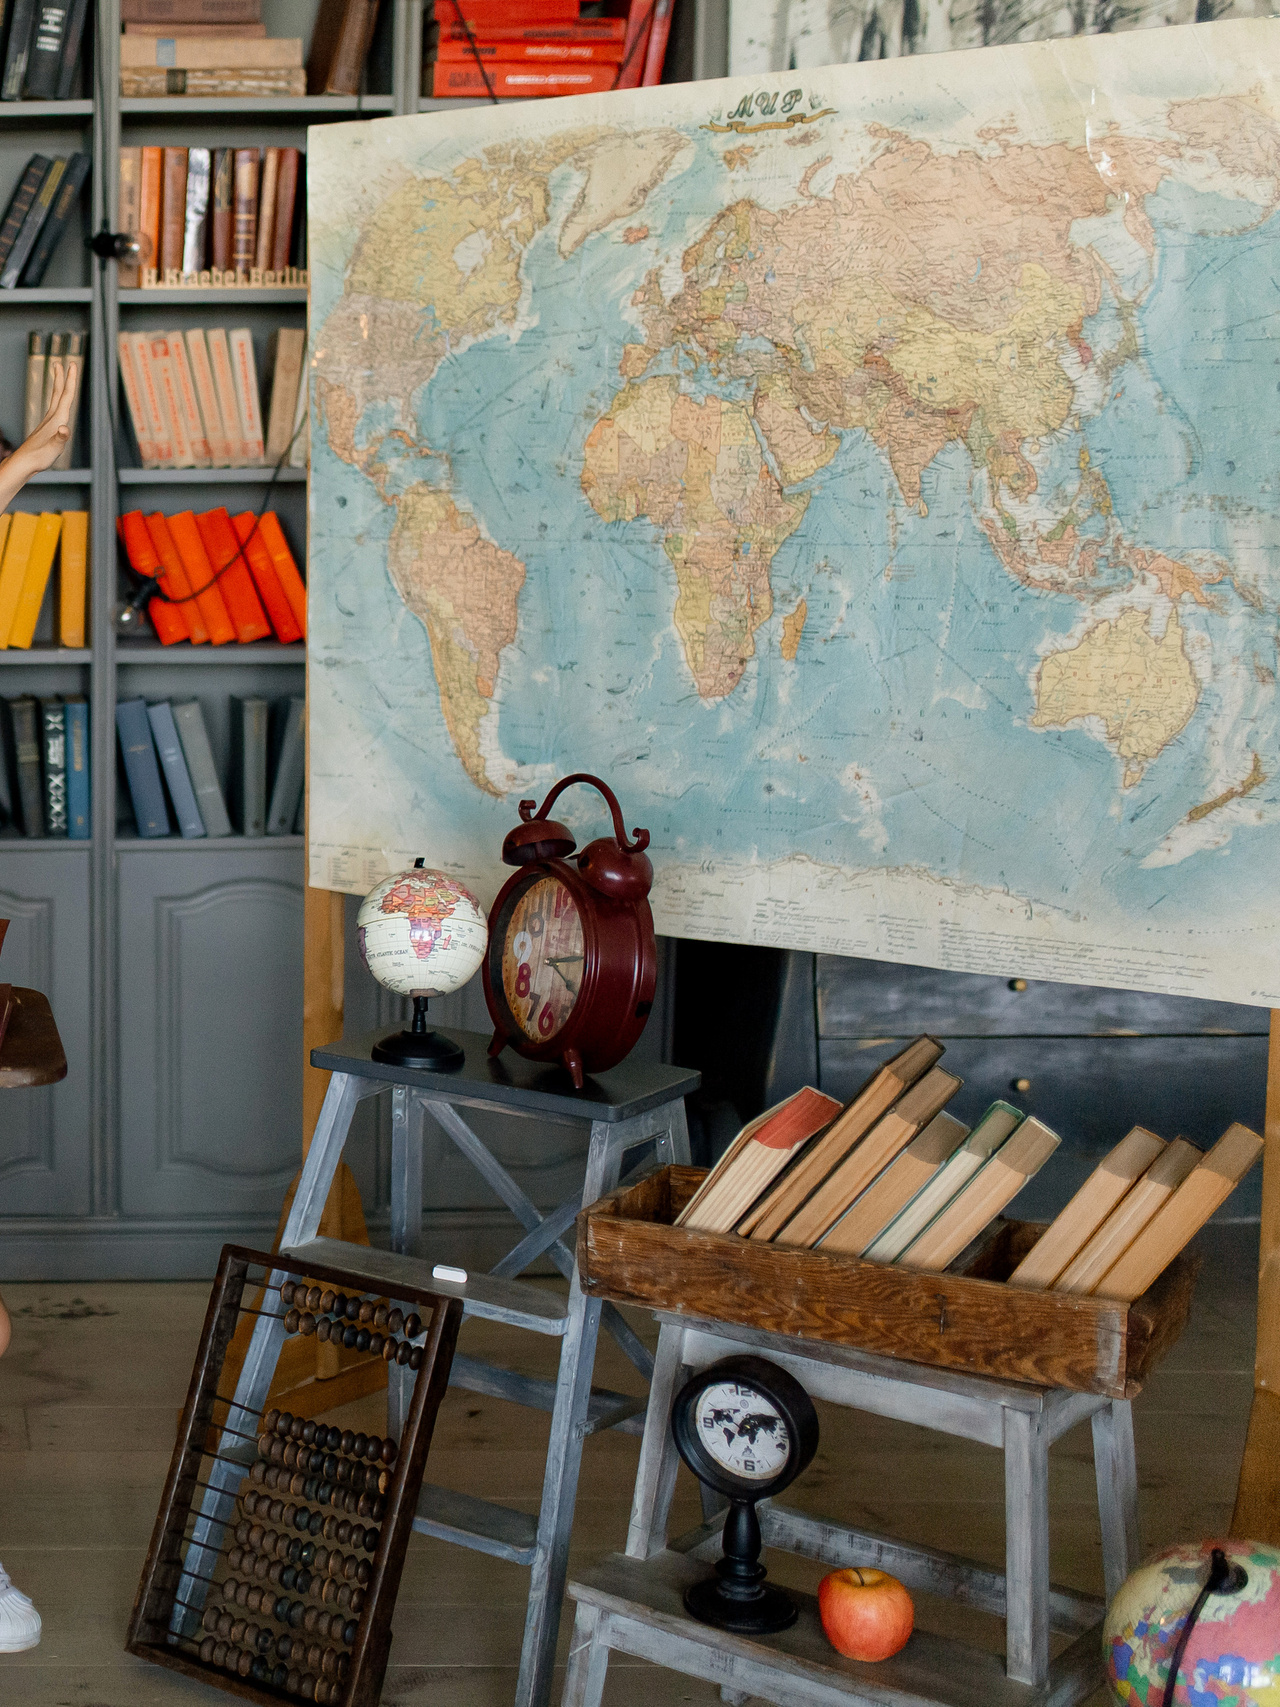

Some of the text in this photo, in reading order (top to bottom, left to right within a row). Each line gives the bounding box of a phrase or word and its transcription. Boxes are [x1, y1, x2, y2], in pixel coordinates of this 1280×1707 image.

[513, 931, 532, 968] 9
[515, 962, 531, 998] 8
[527, 991, 541, 1022] 7
[538, 1002, 554, 1037] 6
[703, 1417, 714, 1429] 9
[744, 1460, 755, 1473] 6
